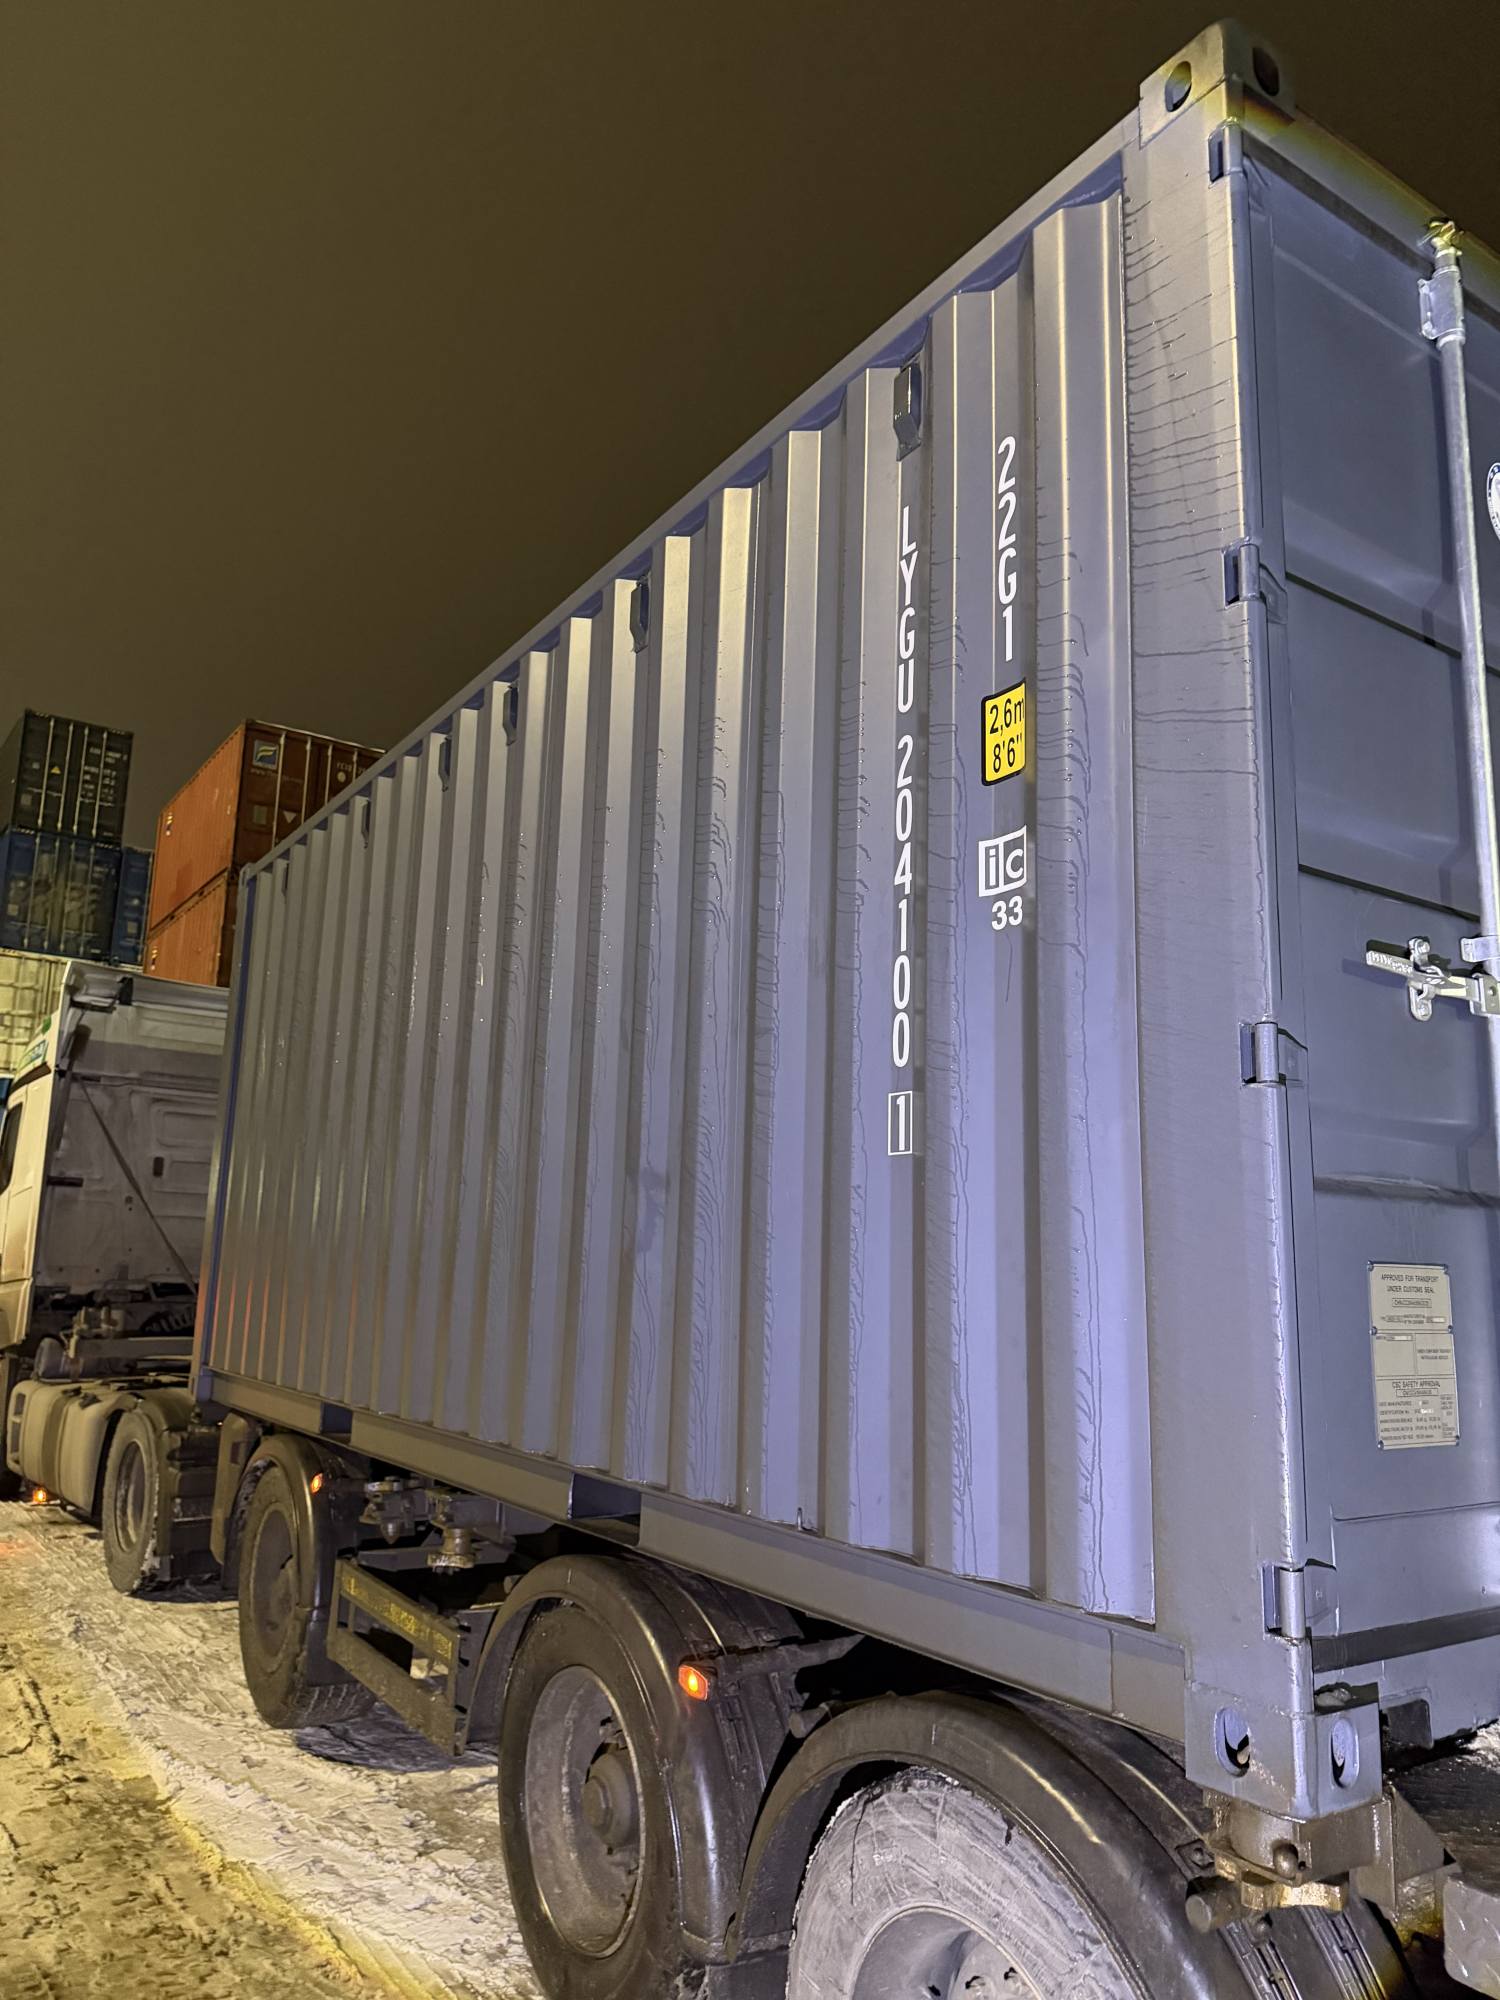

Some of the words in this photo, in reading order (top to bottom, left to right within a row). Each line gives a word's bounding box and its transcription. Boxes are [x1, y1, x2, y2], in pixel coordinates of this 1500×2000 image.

[897, 506, 918, 713] LYGU
[997, 436, 1017, 662] 22G1
[892, 734, 914, 1068] 204100
[991, 895, 1023, 931] 33
